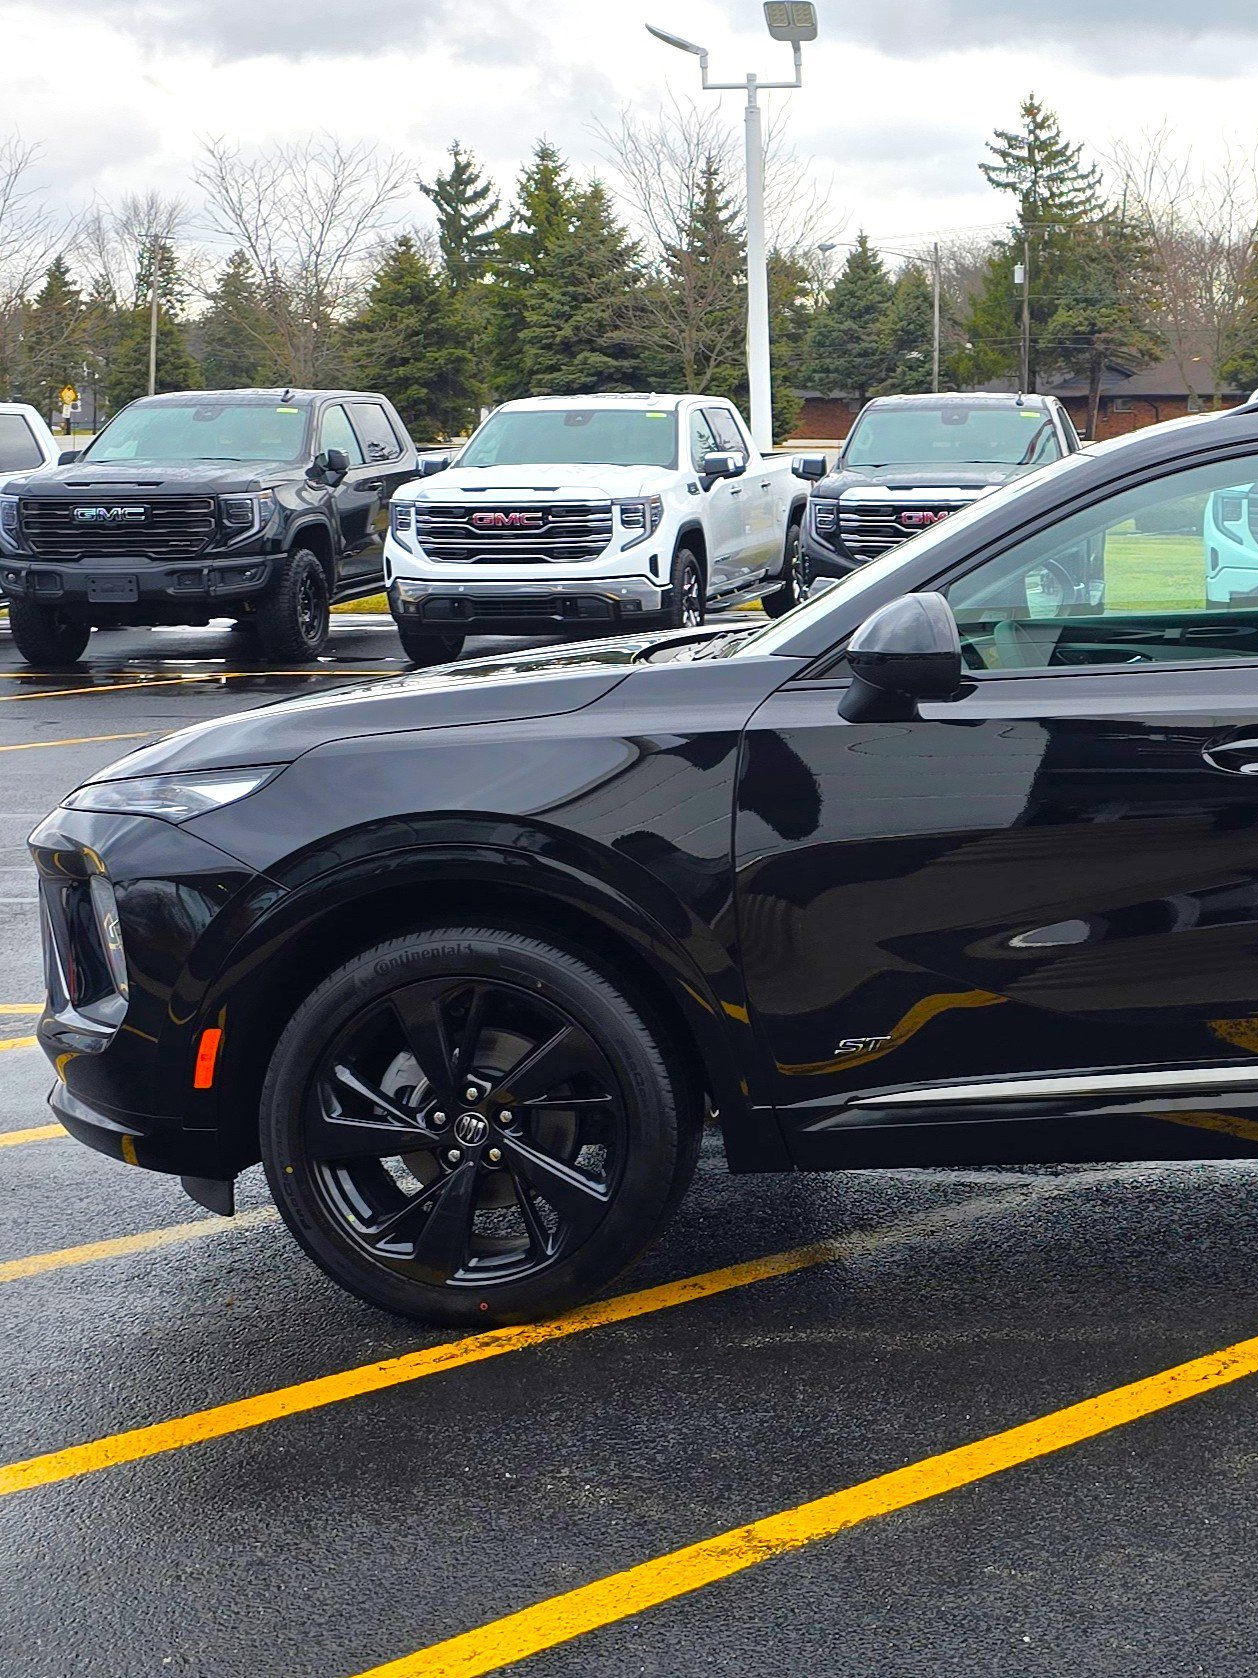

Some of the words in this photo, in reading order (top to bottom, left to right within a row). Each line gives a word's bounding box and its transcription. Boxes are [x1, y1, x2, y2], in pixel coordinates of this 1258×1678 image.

[73, 507, 145, 521] GMC
[472, 512, 543, 526] GMC
[901, 511, 956, 525] GM
[373, 943, 462, 977] Continental
[834, 1035, 892, 1054] ST
